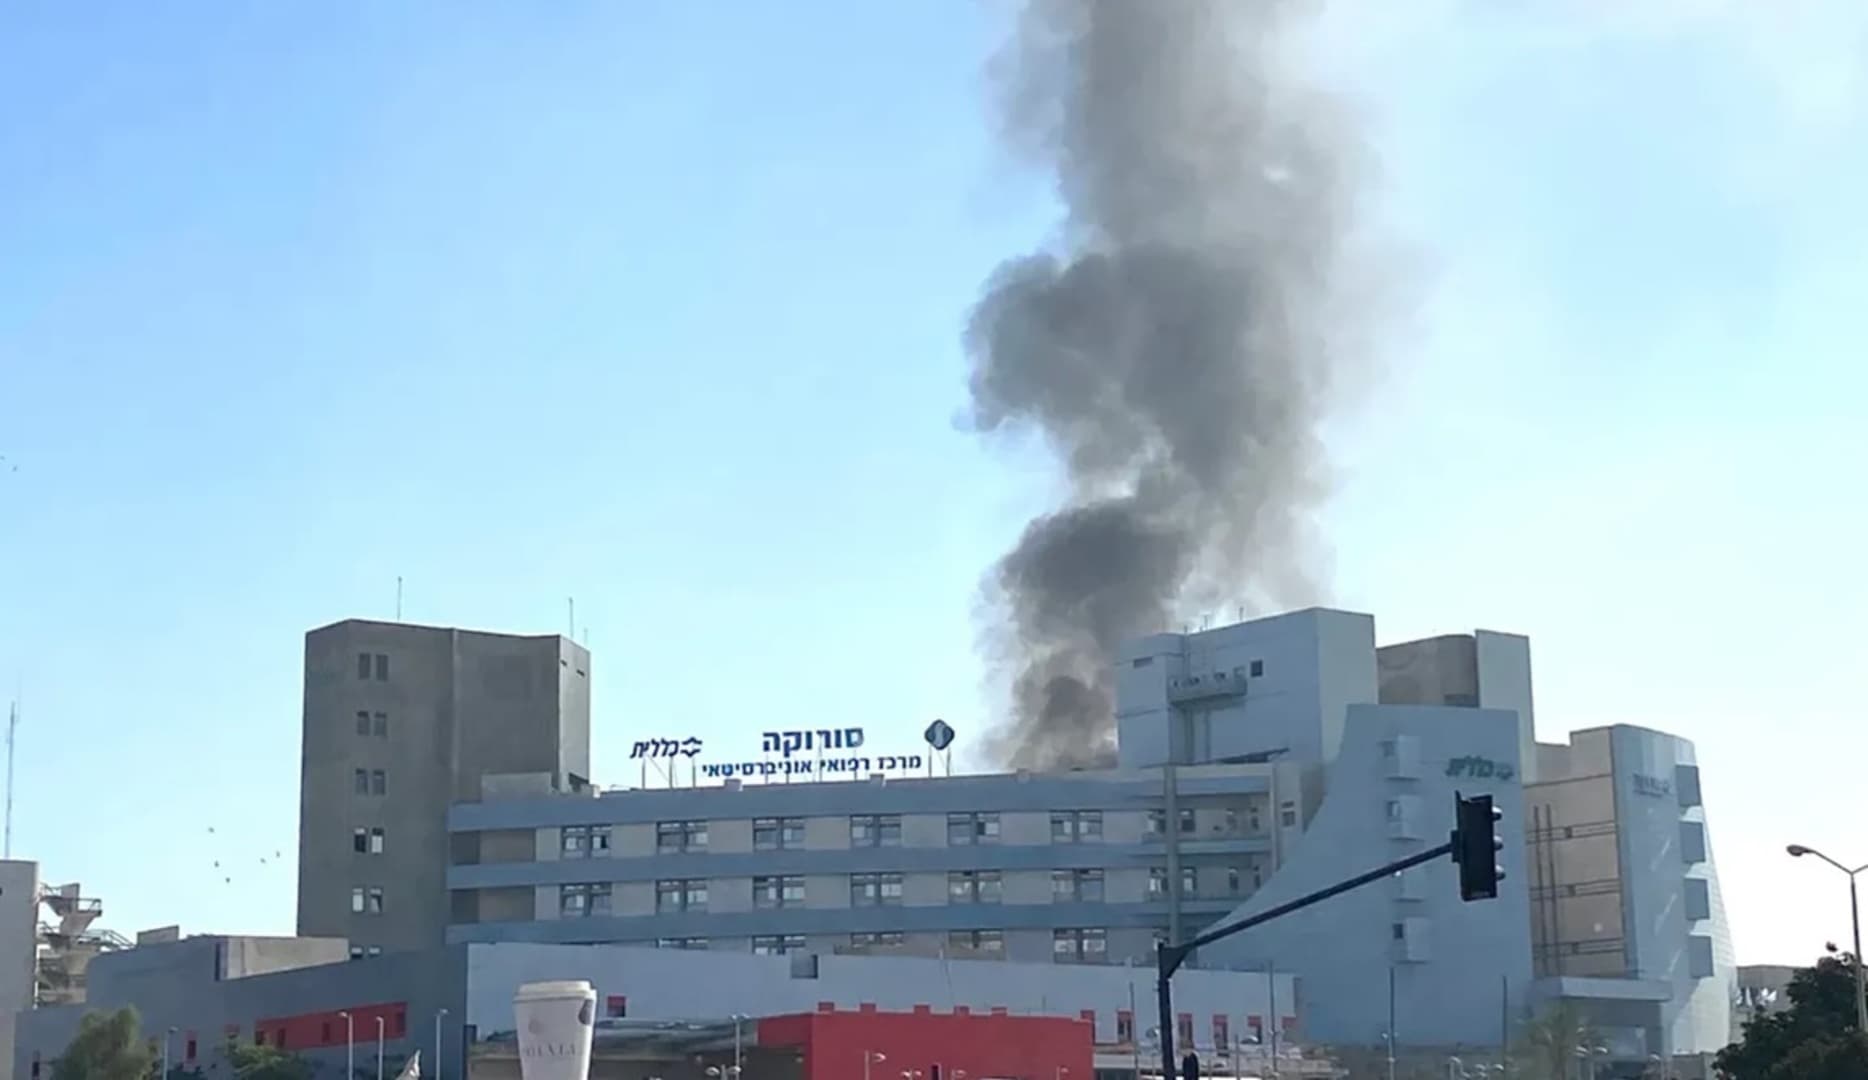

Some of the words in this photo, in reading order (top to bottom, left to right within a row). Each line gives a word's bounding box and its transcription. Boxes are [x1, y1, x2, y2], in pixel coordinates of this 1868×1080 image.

[629, 737, 679, 759] כללית
[763, 728, 864, 758] סורוקה
[702, 760, 812, 777] אוניברסיטאי
[820, 757, 870, 773] רפואי
[877, 755, 922, 770] מרכז
